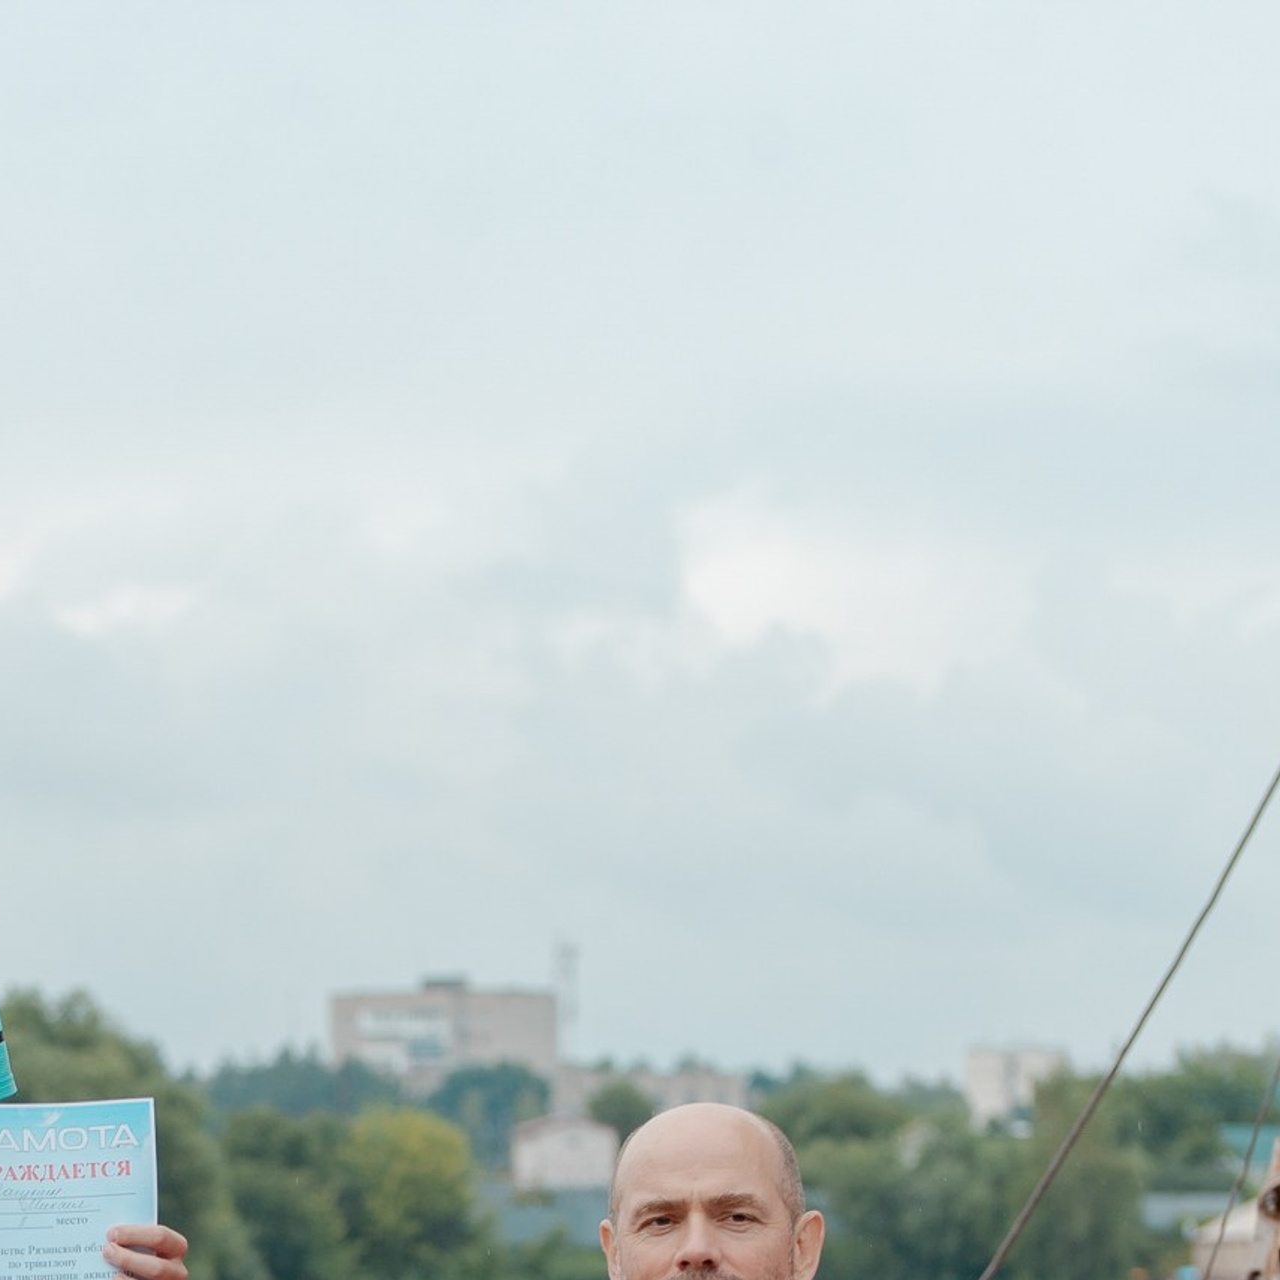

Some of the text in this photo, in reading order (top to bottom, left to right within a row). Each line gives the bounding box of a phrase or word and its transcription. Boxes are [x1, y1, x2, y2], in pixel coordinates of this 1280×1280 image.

[55, 1217, 89, 1226] место
[28, 1245, 82, 1257] Рязанской
[8, 1259, 77, 1270] по триатлону
